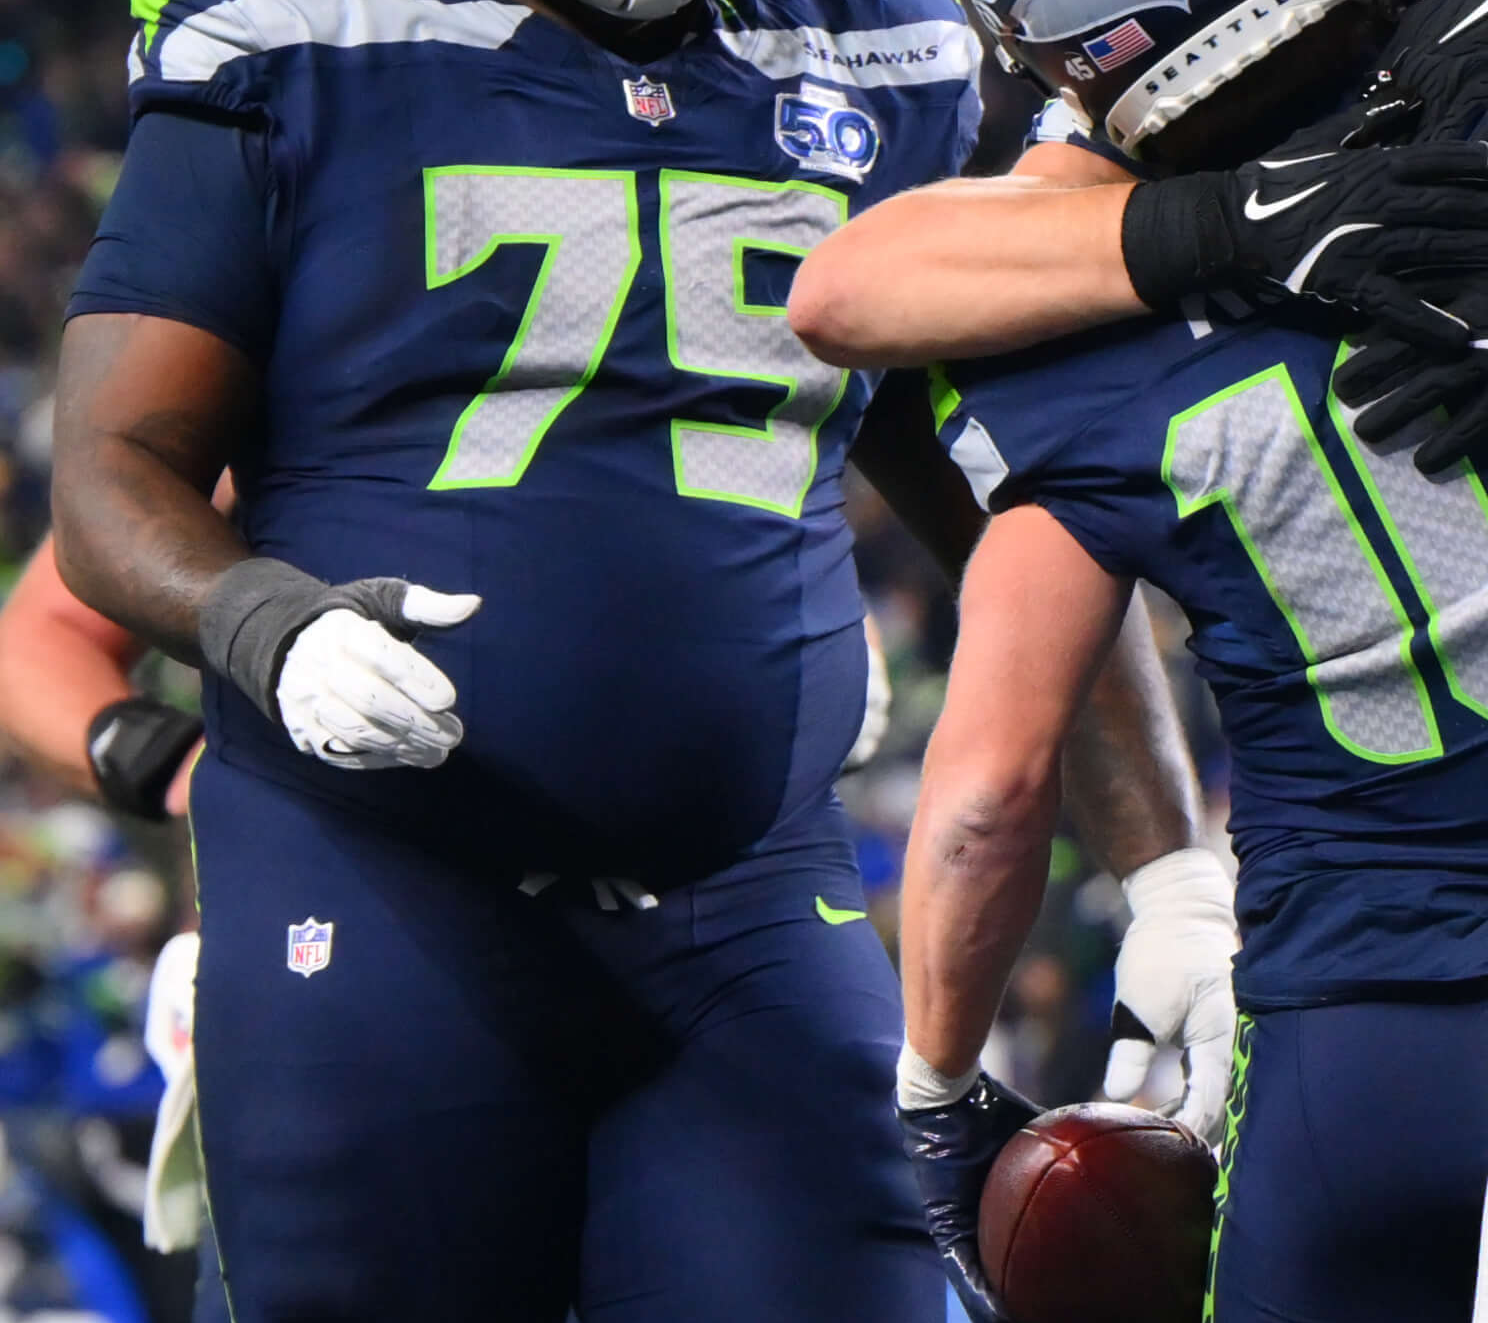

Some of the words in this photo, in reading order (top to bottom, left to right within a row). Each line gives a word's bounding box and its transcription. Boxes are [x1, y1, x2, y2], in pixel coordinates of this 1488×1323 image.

[803, 43, 939, 70] SEAHAWKS
[1064, 56, 1096, 81] 45
[633, 96, 668, 117] NFL
[778, 97, 876, 168] 50
[422, 164, 850, 521] 75
[294, 944, 323, 966] NFL
